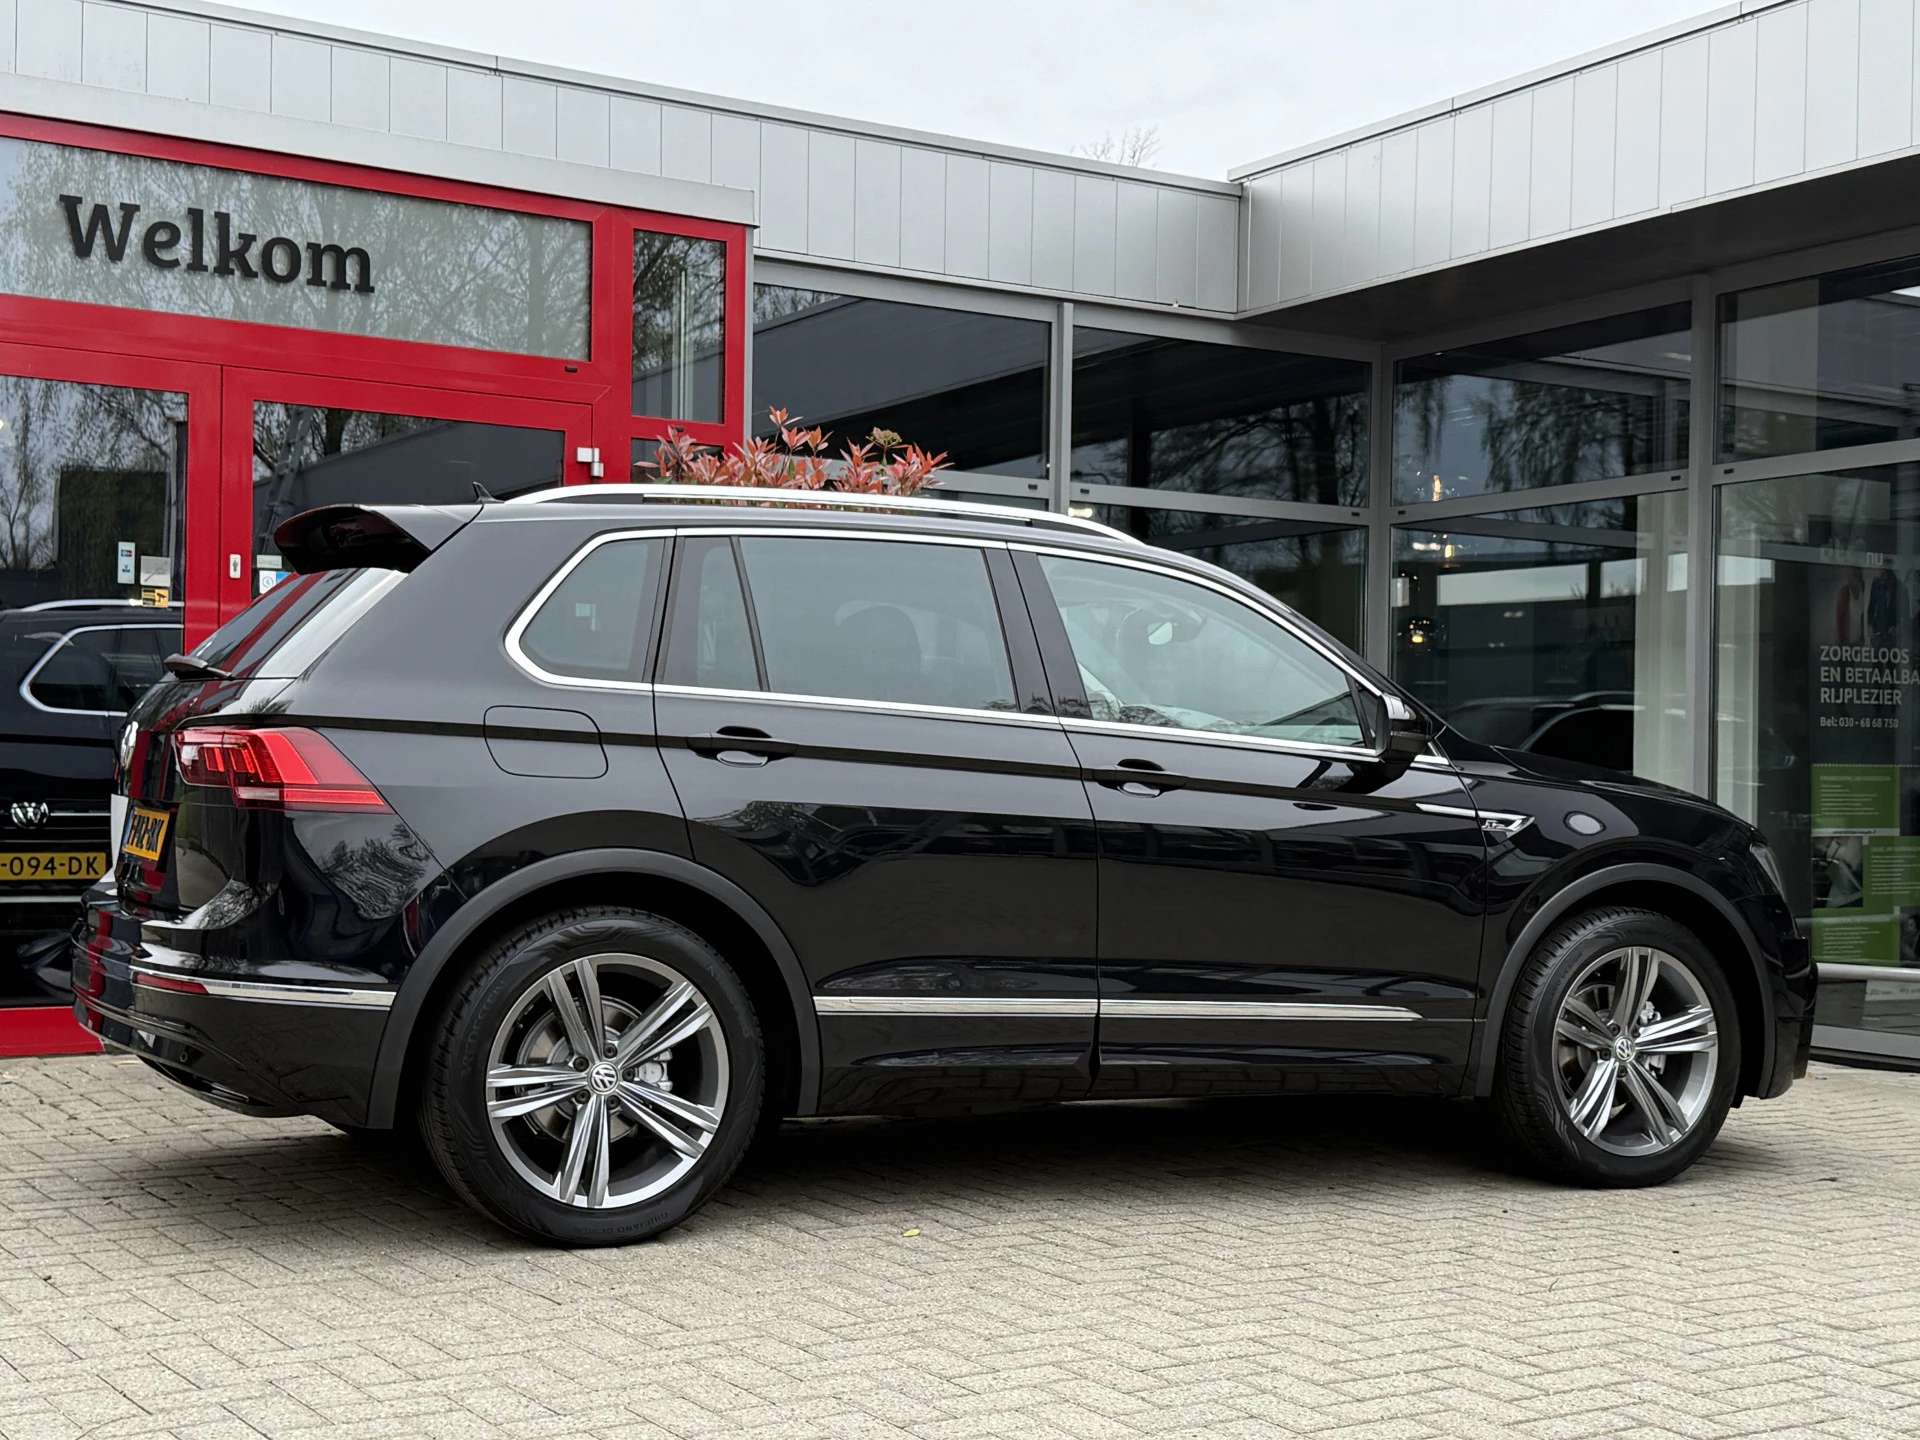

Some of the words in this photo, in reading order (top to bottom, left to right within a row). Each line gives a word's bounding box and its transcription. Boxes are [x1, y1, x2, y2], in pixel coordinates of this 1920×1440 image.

[59, 194, 375, 293] Welkom
[1820, 645, 1910, 664] ZORGELOOS
[1820, 666, 1841, 682] EN
[1820, 687, 1902, 705] RIJPLEZIER
[1820, 716, 1837, 727] Bel:
[1839, 717, 1853, 727] 030
